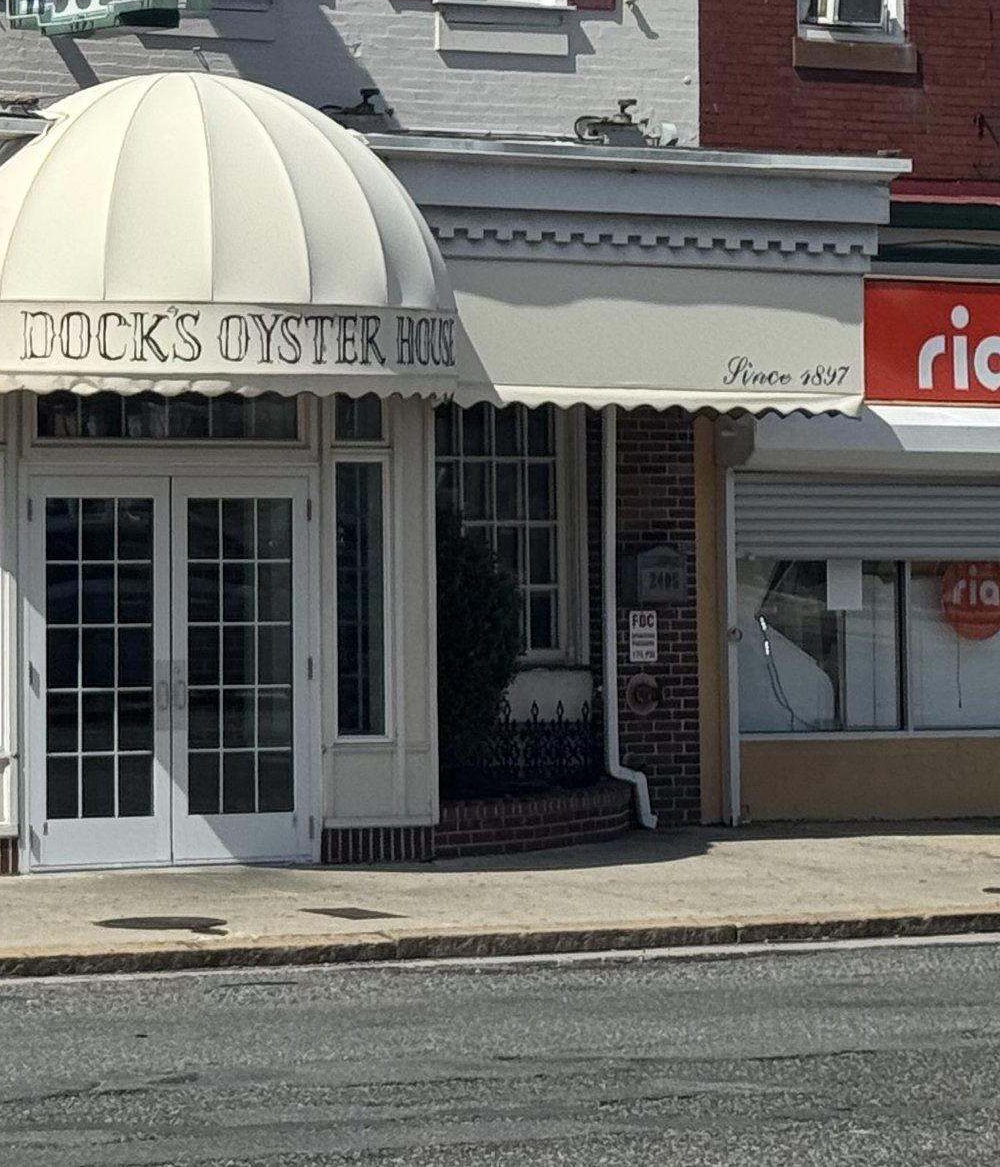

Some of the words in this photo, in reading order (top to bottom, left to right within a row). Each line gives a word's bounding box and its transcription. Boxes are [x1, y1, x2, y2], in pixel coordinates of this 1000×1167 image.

[20, 305, 202, 364] DOCK'S
[217, 311, 387, 366] OYSTER
[722, 355, 792, 387] Since
[800, 365, 850, 387] 1897
[948, 561, 1000, 606] ria
[632, 613, 655, 628] FDC
